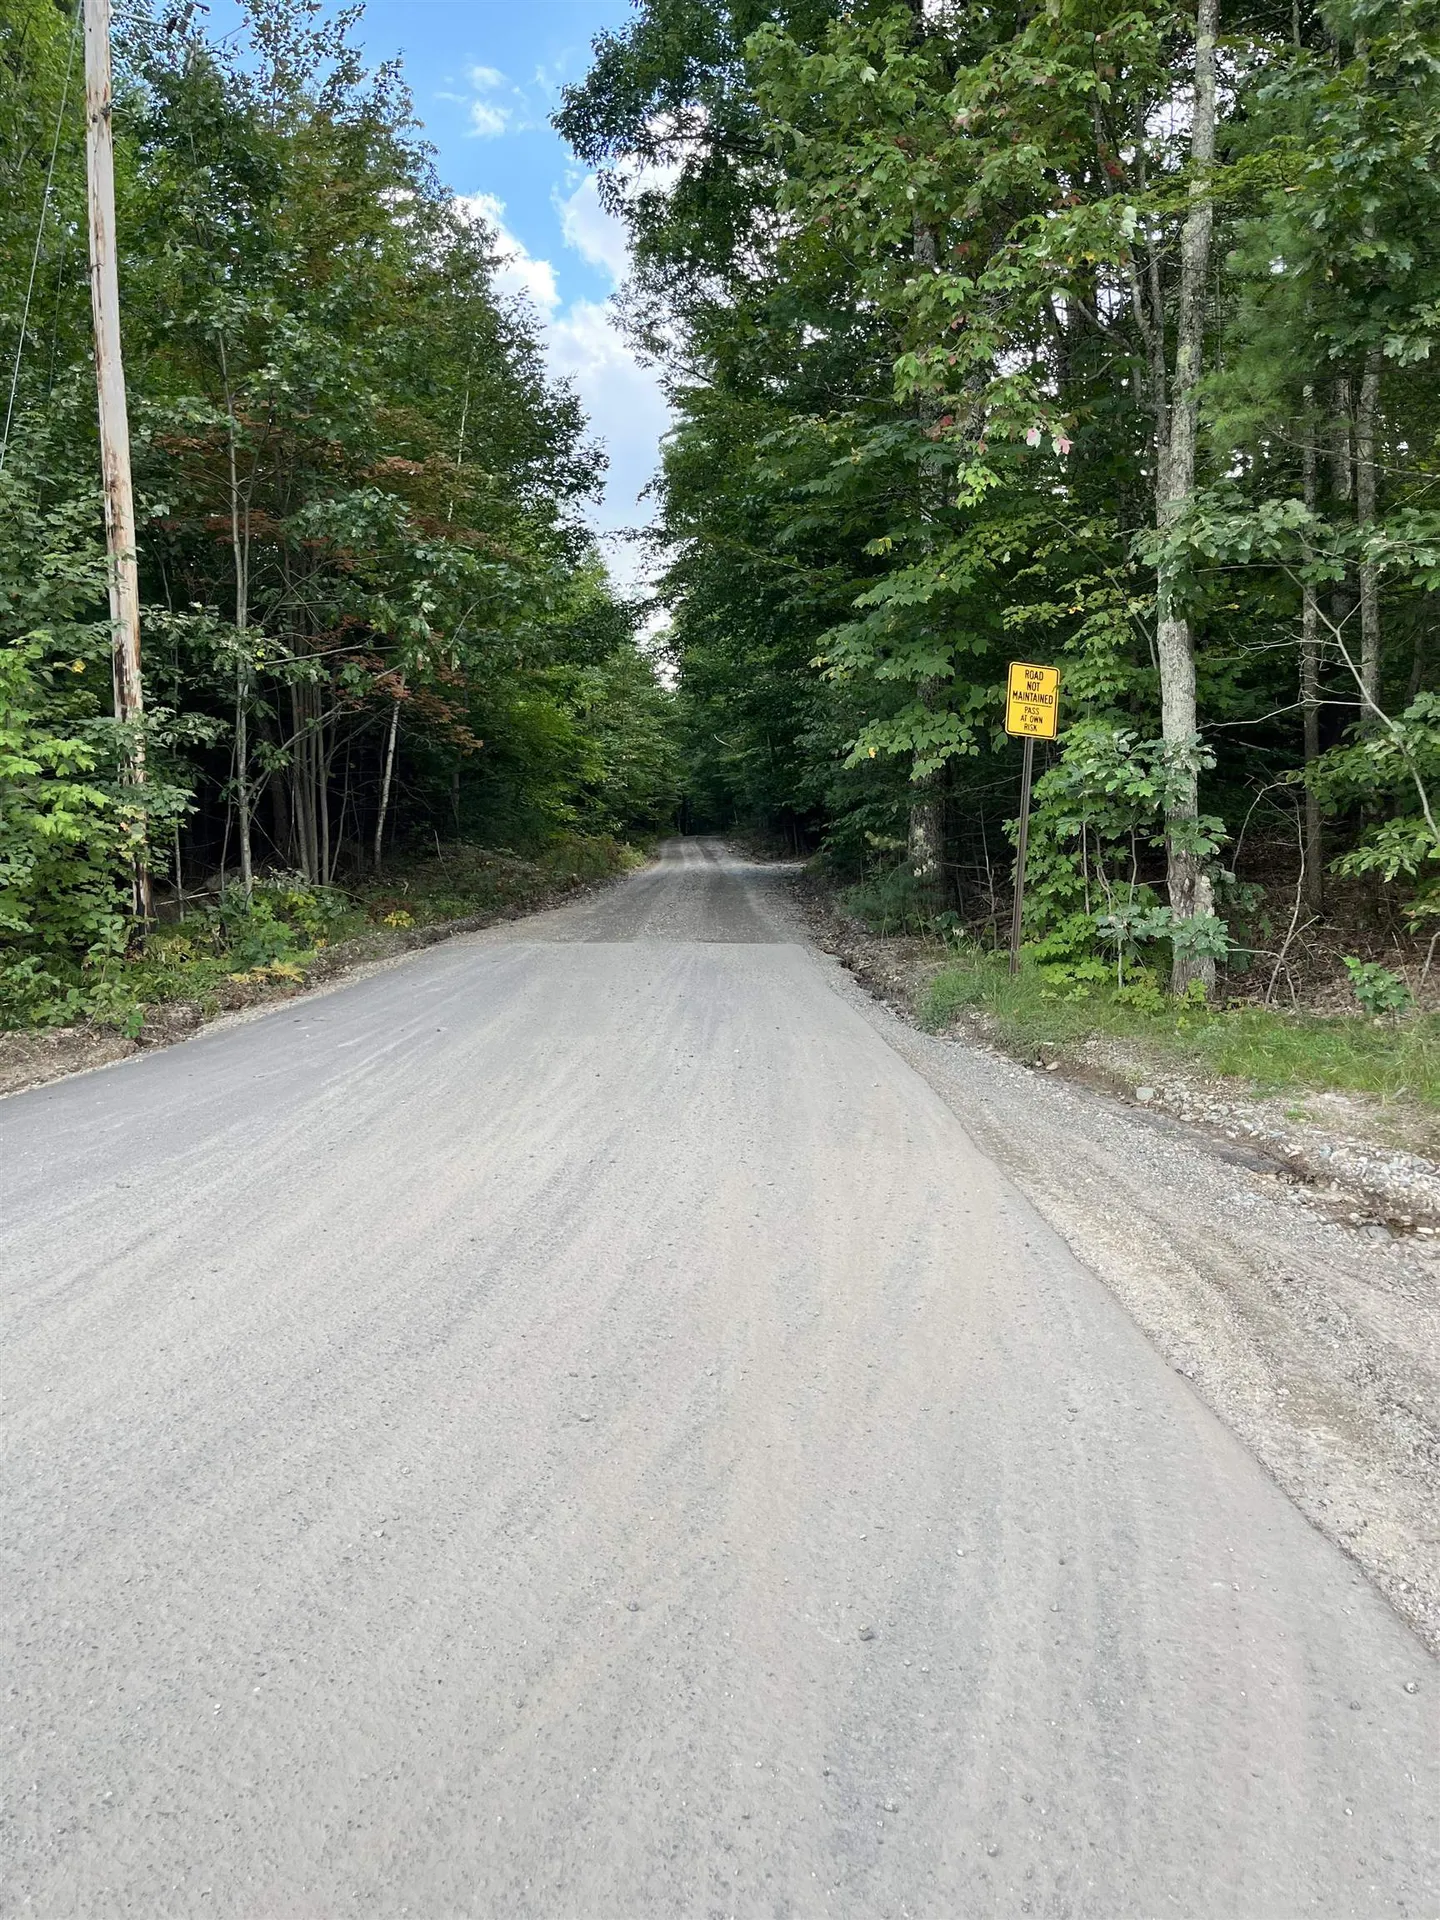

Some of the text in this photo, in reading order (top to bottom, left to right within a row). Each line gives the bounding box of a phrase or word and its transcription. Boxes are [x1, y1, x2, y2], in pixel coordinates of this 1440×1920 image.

[1025, 669, 1044, 681] ROAD
[1026, 681, 1040, 692] NOT
[1012, 690, 1054, 705] MAINTAINED
[1024, 706, 1040, 715] PASS
[1020, 714, 1043, 724] AT OWN
[1024, 723, 1038, 732] RISK
